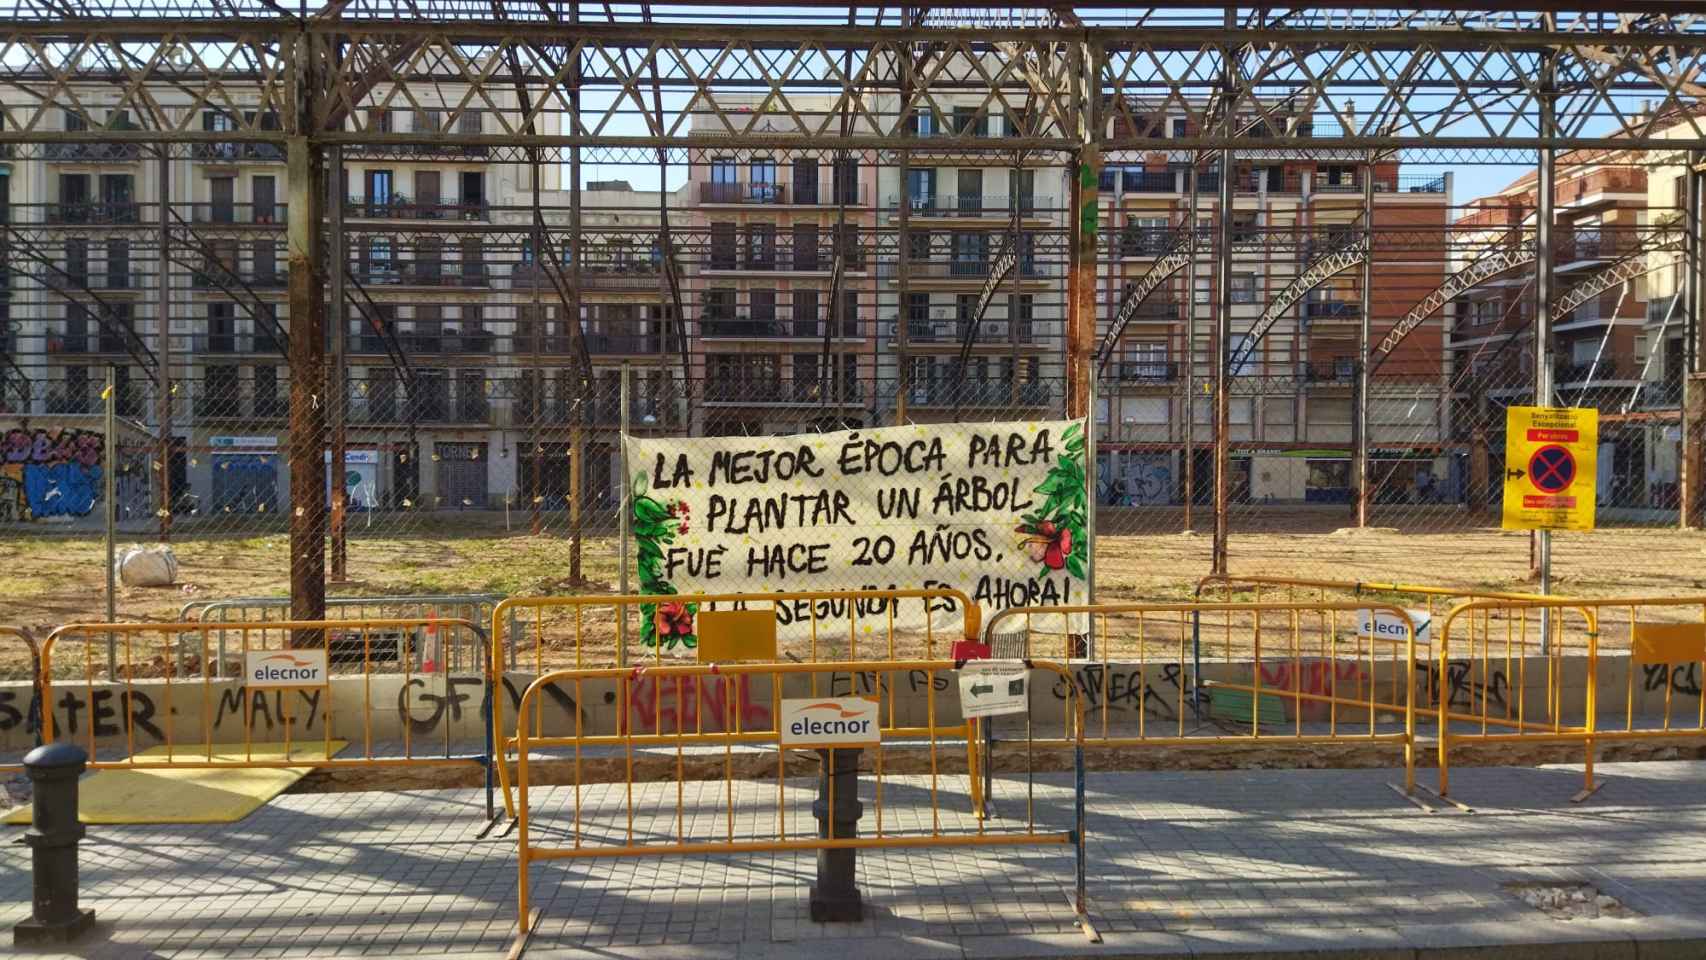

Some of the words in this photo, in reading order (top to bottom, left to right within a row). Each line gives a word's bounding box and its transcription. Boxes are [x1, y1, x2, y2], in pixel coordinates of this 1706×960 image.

[653, 452, 694, 489] LA
[708, 445, 825, 487] MEJOR
[837, 432, 947, 476] ÉPOCA
[968, 429, 1054, 468] PARA
[706, 488, 856, 534] PLANTAR
[877, 487, 921, 519] UN
[932, 473, 1033, 516] ÁRBOL
[747, 543, 831, 579] HACE
[852, 535, 896, 566] 20
[923, 580, 956, 613] ES
[255, 665, 318, 680] elecnor
[791, 716, 870, 736] elecnor
